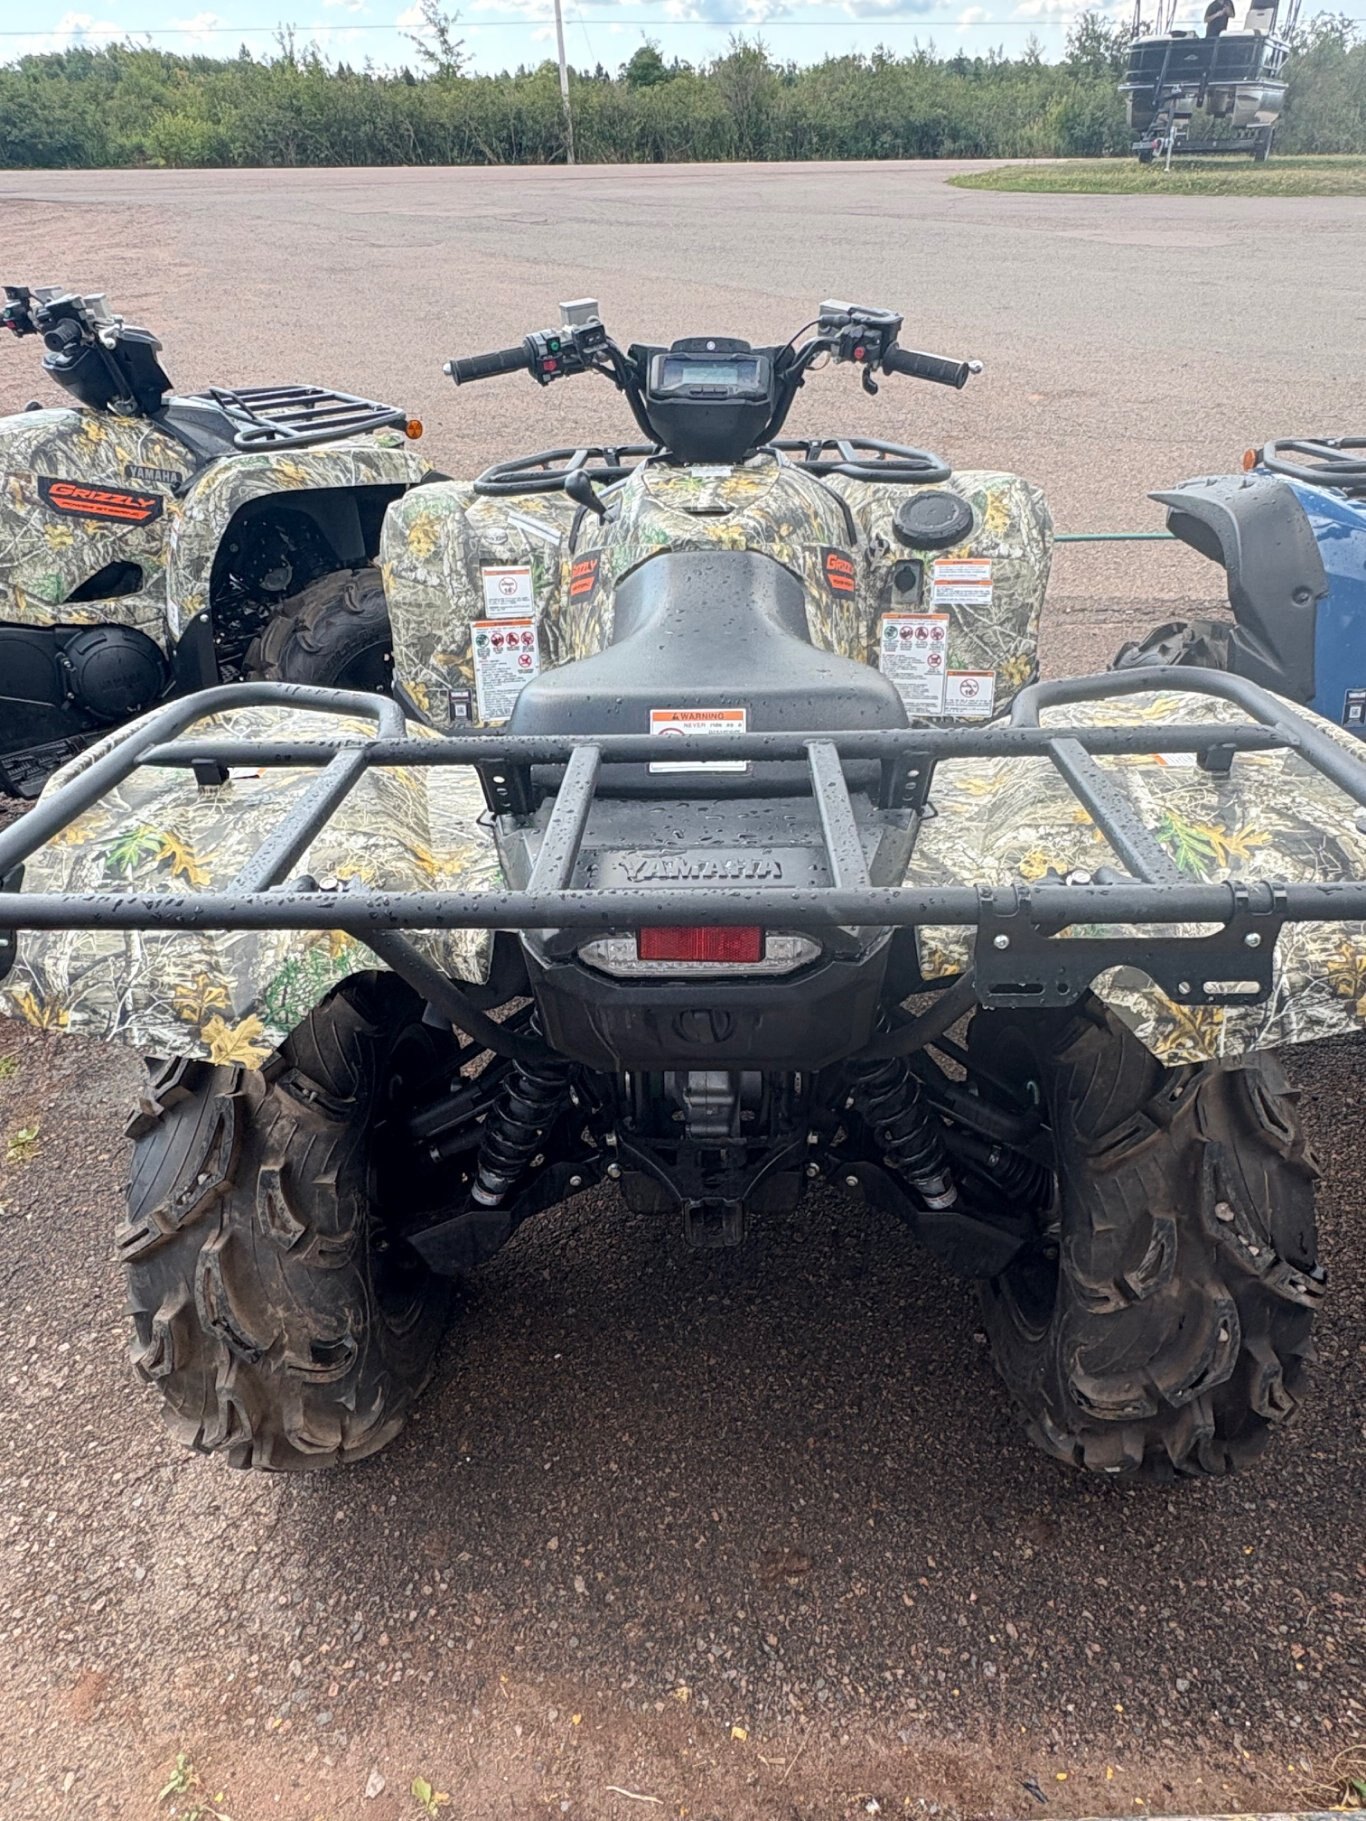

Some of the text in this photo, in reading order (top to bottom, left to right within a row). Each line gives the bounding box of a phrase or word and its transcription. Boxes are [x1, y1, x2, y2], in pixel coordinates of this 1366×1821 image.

[130, 466, 178, 482] YAMAHA
[48, 482, 156, 508] GRIZZLY
[680, 712, 725, 720] WARNING
[618, 858, 783, 882] YAMAHA
